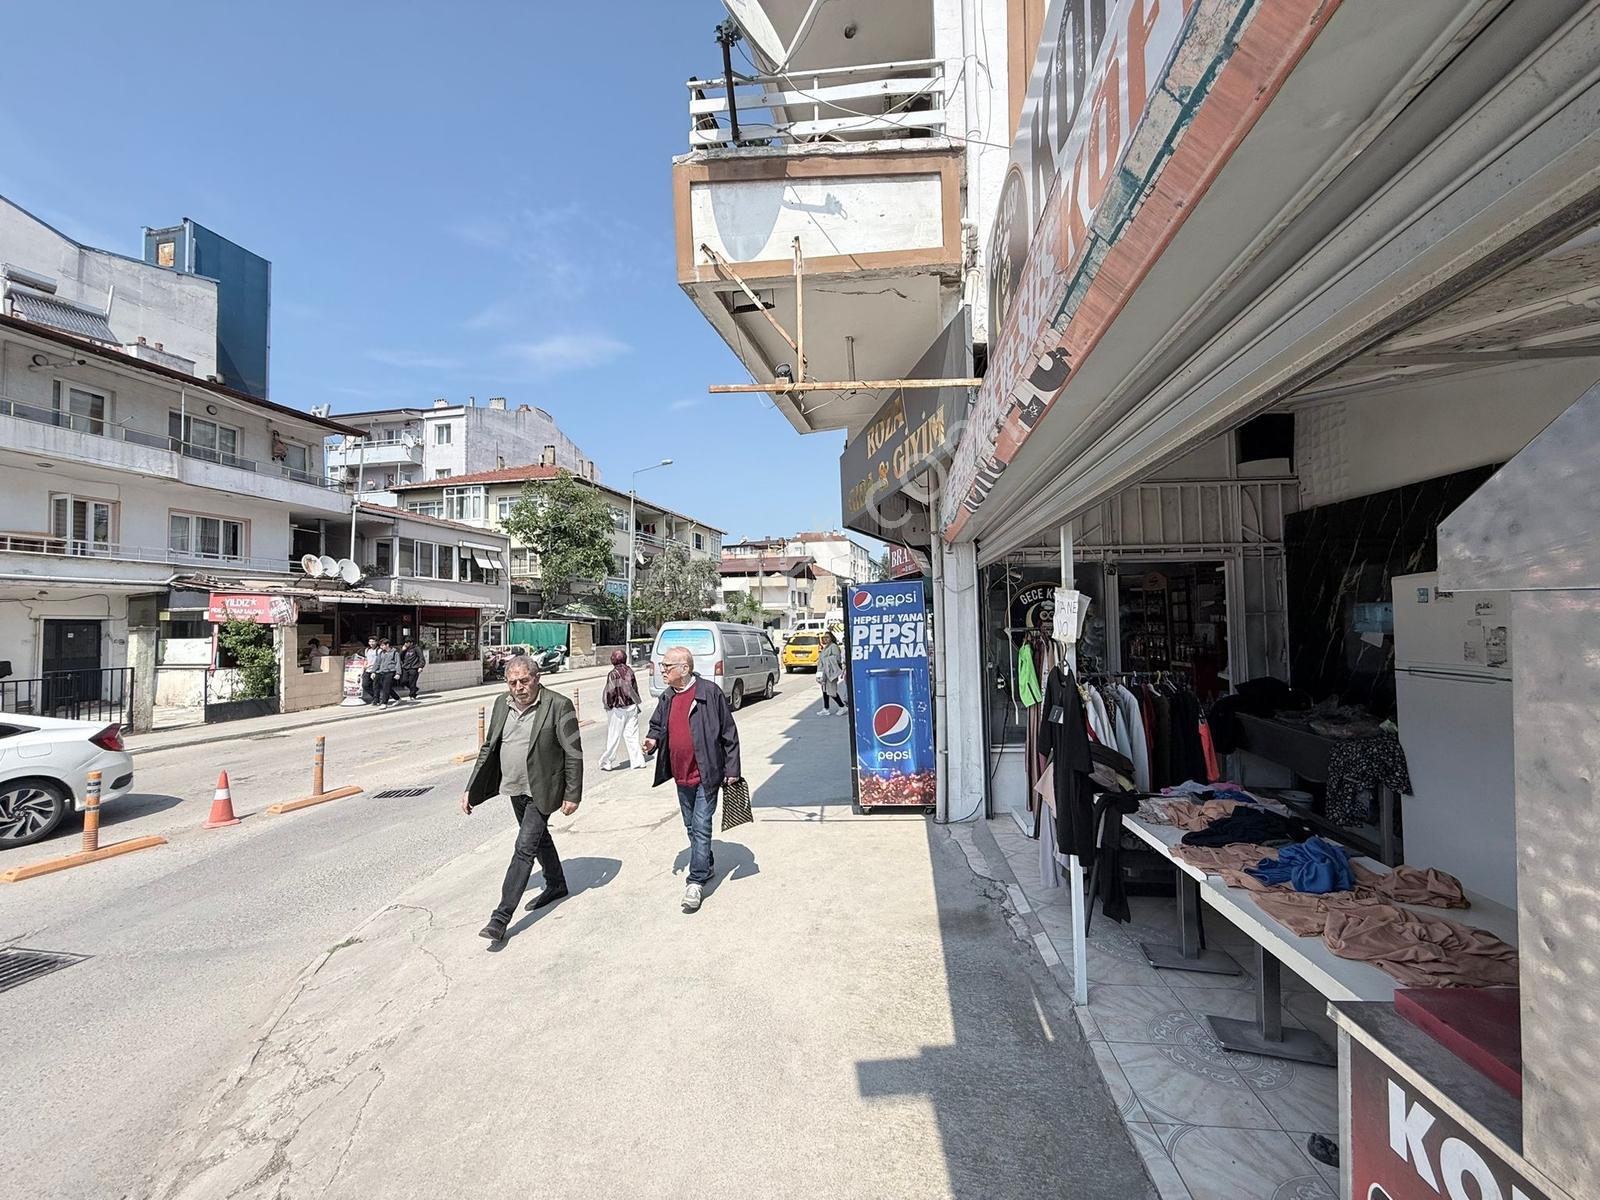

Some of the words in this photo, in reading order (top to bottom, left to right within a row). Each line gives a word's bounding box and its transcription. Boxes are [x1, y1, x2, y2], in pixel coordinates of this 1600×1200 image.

[891, 548, 911, 568] BRA
[875, 590, 918, 608] pepsi
[1020, 588, 1044, 605] GECE
[897, 612, 924, 623] YANA
[852, 622, 924, 646] PEPSI
[877, 642, 927, 659] YANA
[877, 748, 912, 762] pepsi
[1387, 1078, 1531, 1200] KO
